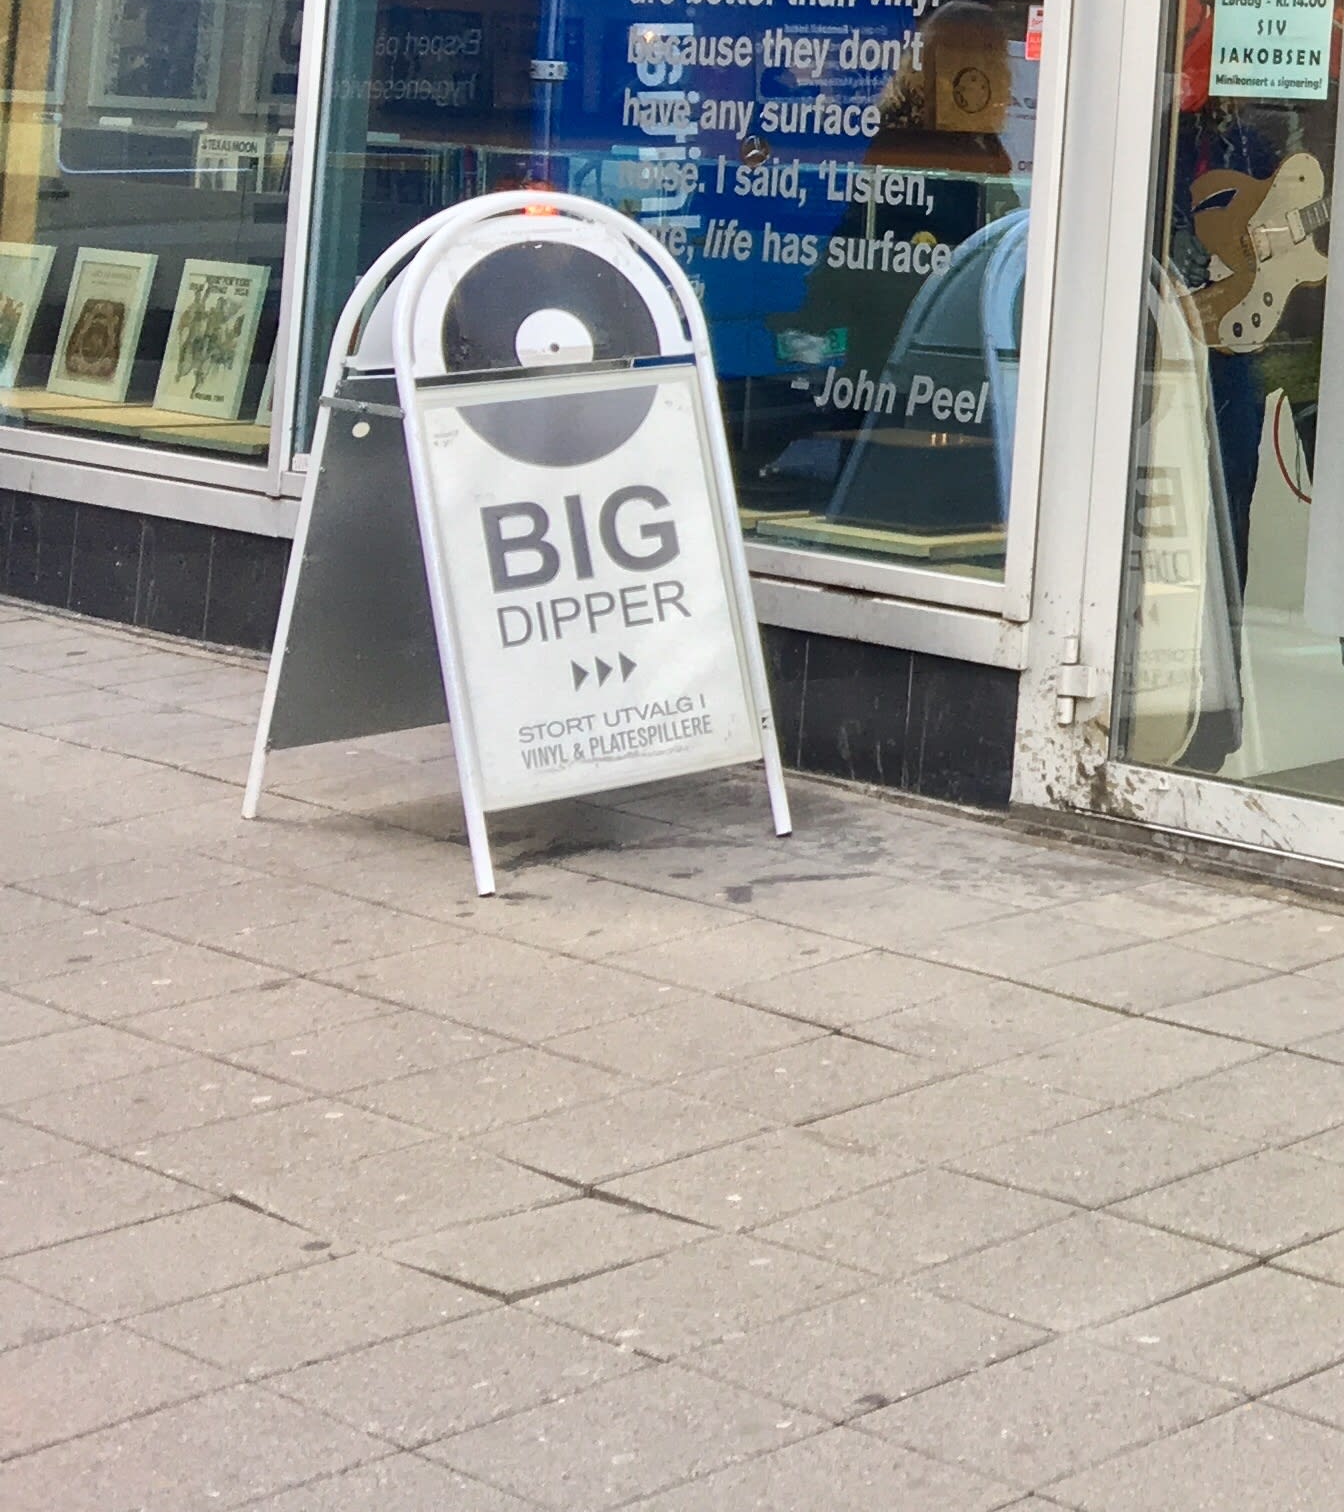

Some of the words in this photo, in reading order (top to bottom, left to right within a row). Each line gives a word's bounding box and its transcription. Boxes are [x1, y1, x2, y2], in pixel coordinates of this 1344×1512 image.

[627, 26, 752, 68] because
[763, 28, 828, 78] they
[838, 28, 924, 72] don't
[1257, 19, 1287, 36] SIV
[1216, 74, 1269, 87] Minikonsert
[1277, 76, 1322, 90] signering!
[1220, 47, 1321, 66] JAKOBSEN
[622, 88, 692, 127] have
[699, 98, 755, 141] any
[761, 93, 881, 137] surface
[715, 155, 726, 194] I
[734, 155, 807, 209] said,
[703, 219, 752, 261] life
[762, 222, 818, 266] has
[827, 231, 952, 275] surface
[813, 366, 896, 416] John
[906, 373, 989, 424] Peel
[480, 485, 681, 594] BIG
[497, 579, 692, 649] DIPPER
[518, 714, 596, 744] STORT
[603, 696, 694, 728] UTVALG
[521, 738, 568, 770] VINYL
[573, 736, 585, 761] &
[588, 714, 713, 759] PLATESPILLERE
